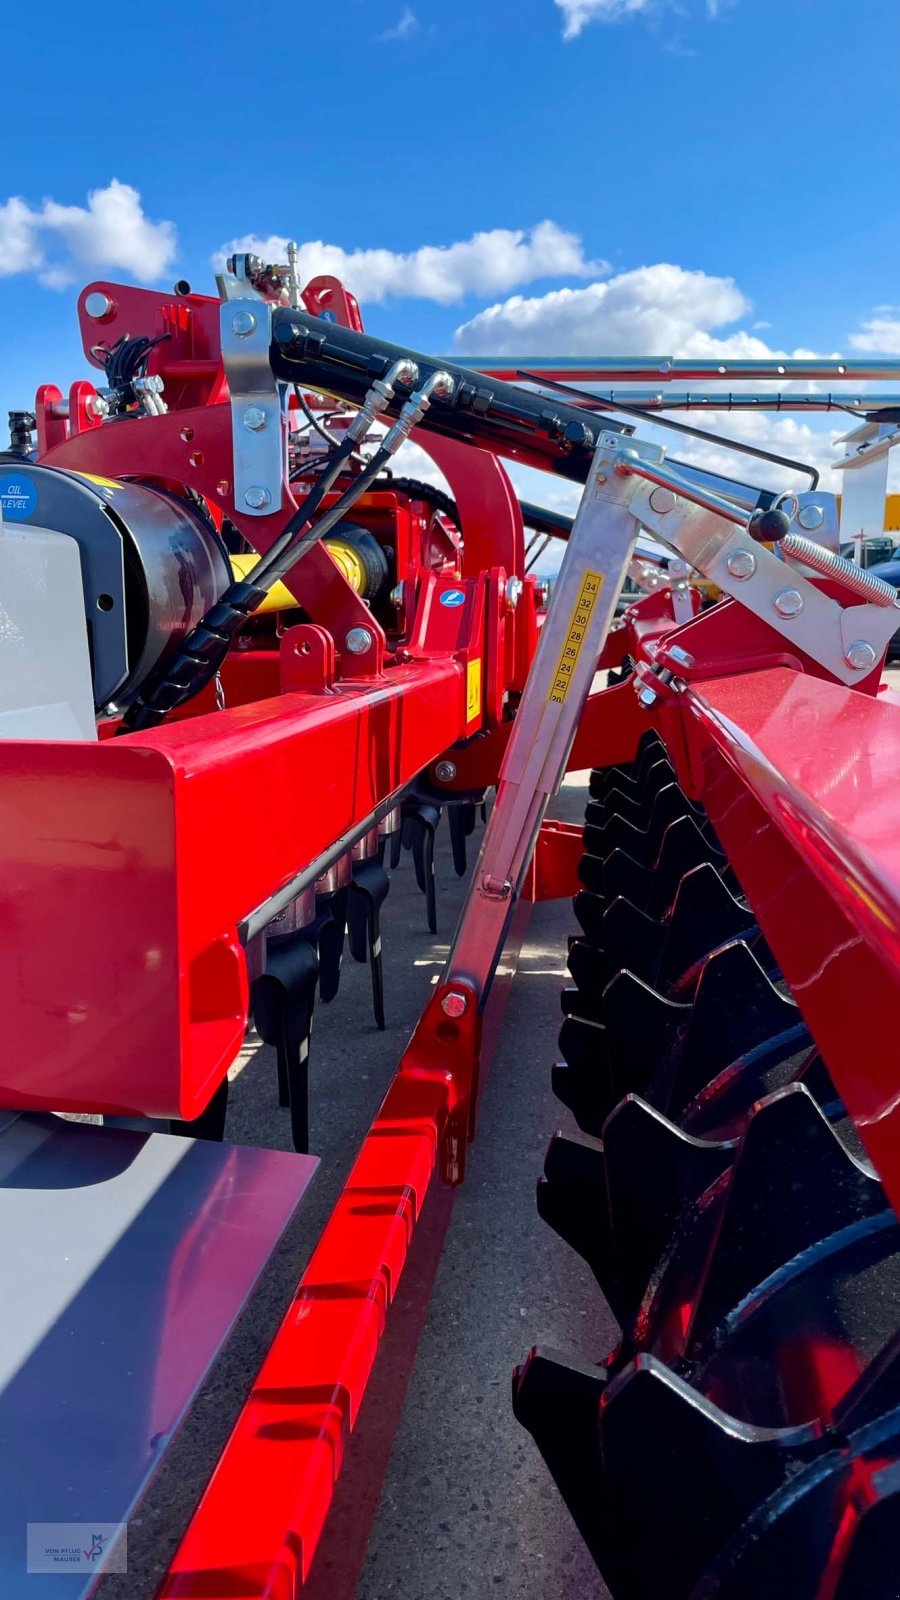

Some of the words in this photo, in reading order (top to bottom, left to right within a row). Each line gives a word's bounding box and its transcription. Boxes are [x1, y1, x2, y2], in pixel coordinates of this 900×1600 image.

[8, 485, 21, 494] OIL
[2, 500, 27, 508] LEVEL
[586, 583, 596, 591] 34
[581, 599, 591, 607] 32
[576, 615, 586, 624] 30
[571, 632, 581, 640] 28
[566, 648, 576, 656] 26
[561, 664, 571, 672] 24
[556, 680, 566, 688] 22
